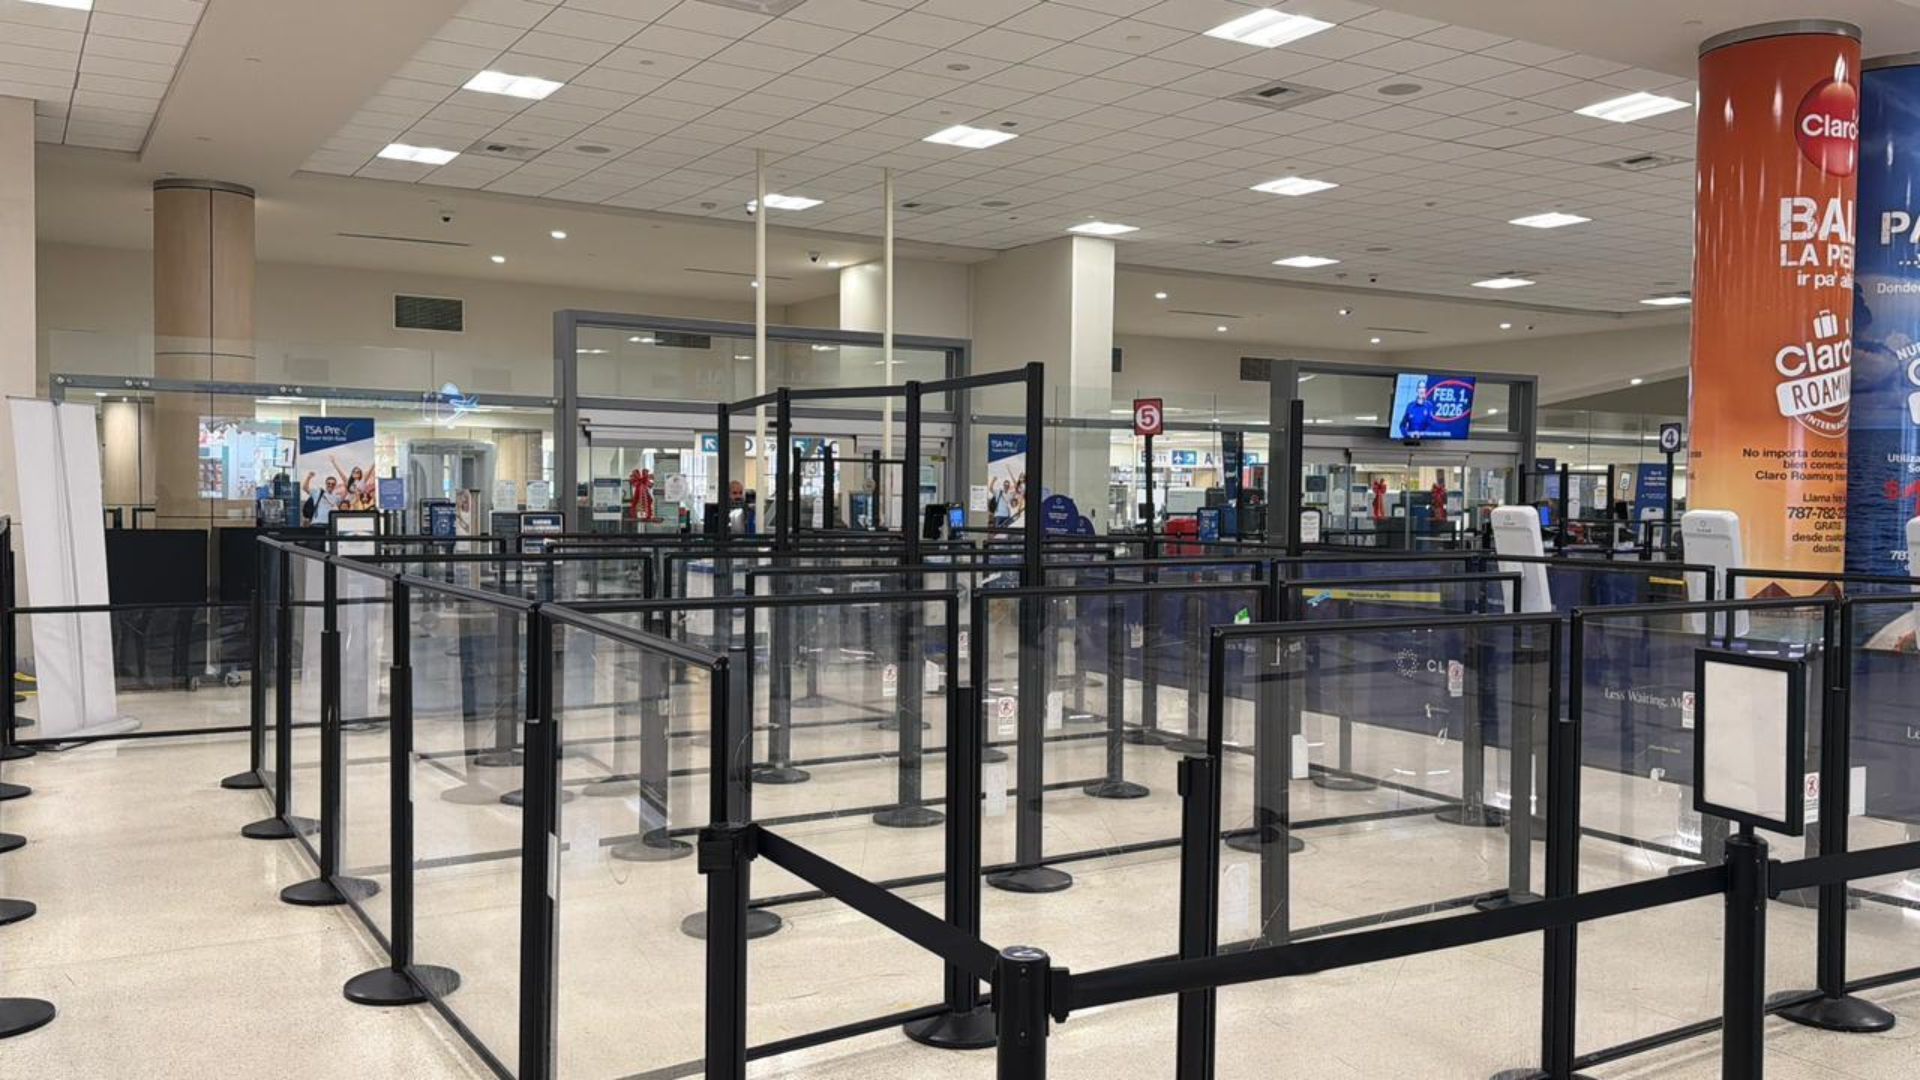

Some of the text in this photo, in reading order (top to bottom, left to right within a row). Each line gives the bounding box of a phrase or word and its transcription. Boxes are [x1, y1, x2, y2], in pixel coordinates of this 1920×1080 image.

[1802, 113, 1856, 140] Claro
[1780, 243, 1819, 267] LA
[1797, 270, 1810, 286] ir
[1814, 271, 1838, 290] pa'
[1775, 338, 1852, 377] Claro
[1433, 388, 1468, 404] FEB. 1,
[1141, 406, 1154, 427] 5
[1435, 402, 1463, 417] 2026
[304, 425, 322, 434] TSA
[1664, 430, 1675, 446] 4
[1742, 448, 1760, 458] No
[1763, 449, 1808, 460] importa
[1755, 470, 1787, 480] Claro
[1790, 471, 1833, 482] Roaming
[1803, 493, 1830, 502] Llama
[1792, 533, 1823, 542] desde
[1604, 687, 1621, 701] Less
